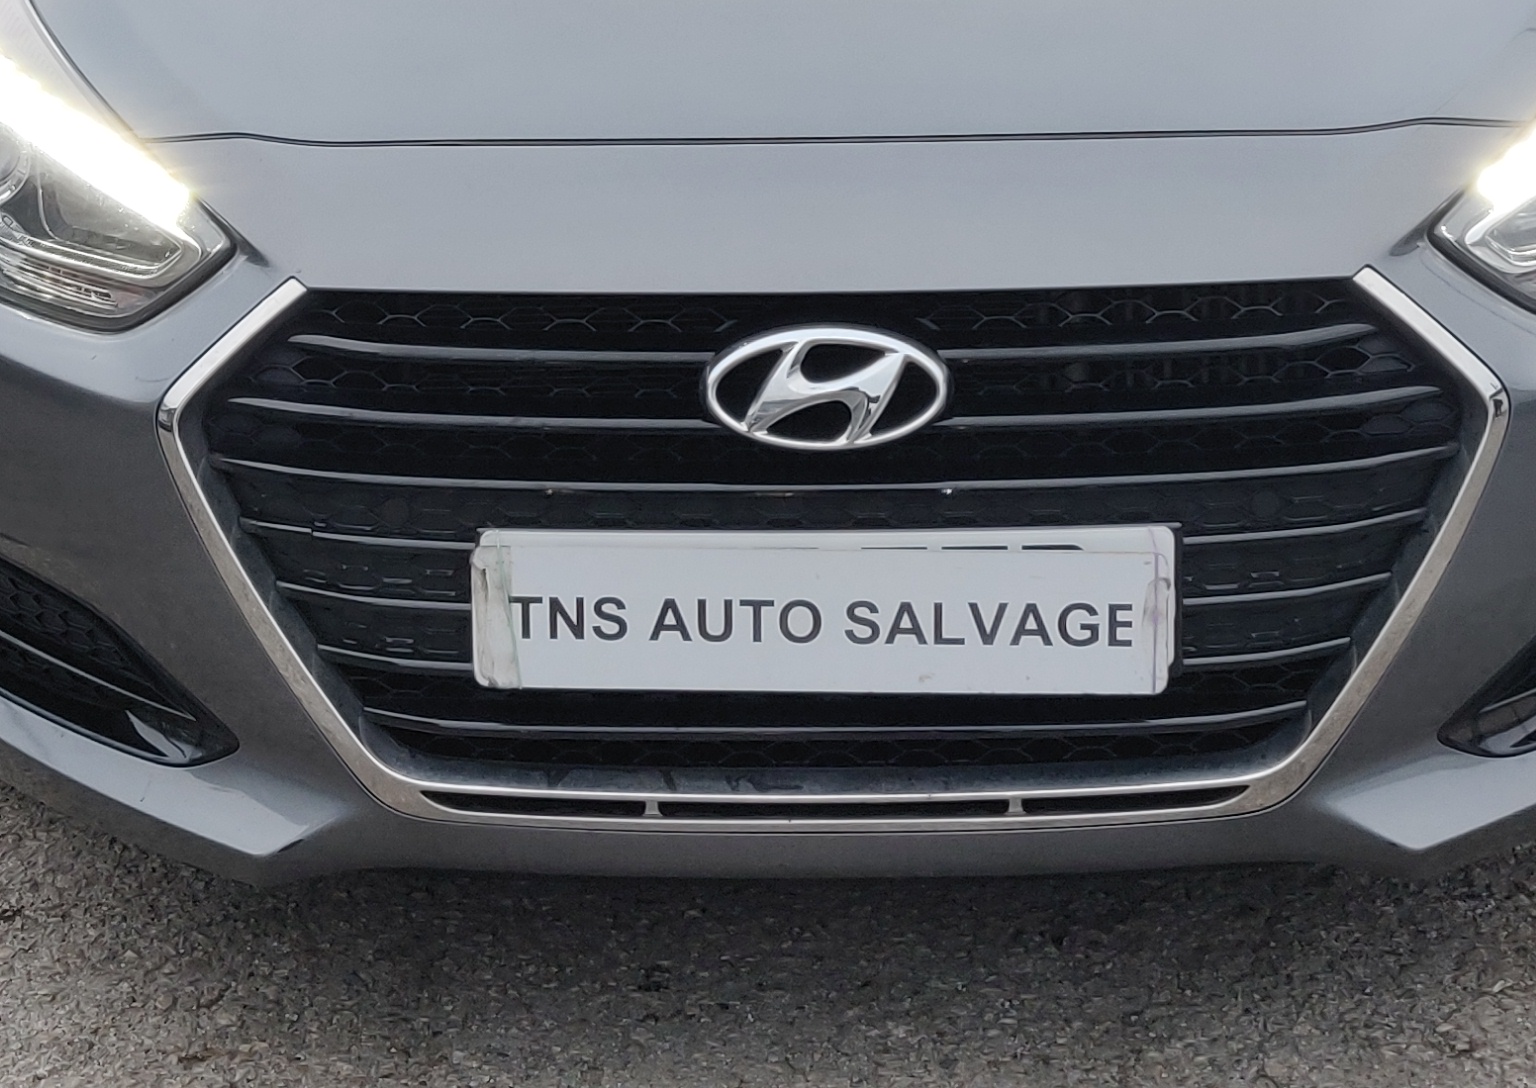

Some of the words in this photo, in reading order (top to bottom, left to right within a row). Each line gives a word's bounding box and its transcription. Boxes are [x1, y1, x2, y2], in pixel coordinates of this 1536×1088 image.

[508, 595, 629, 642] TNS
[648, 597, 823, 645] AUTO
[843, 598, 1134, 648] SALVAGE
